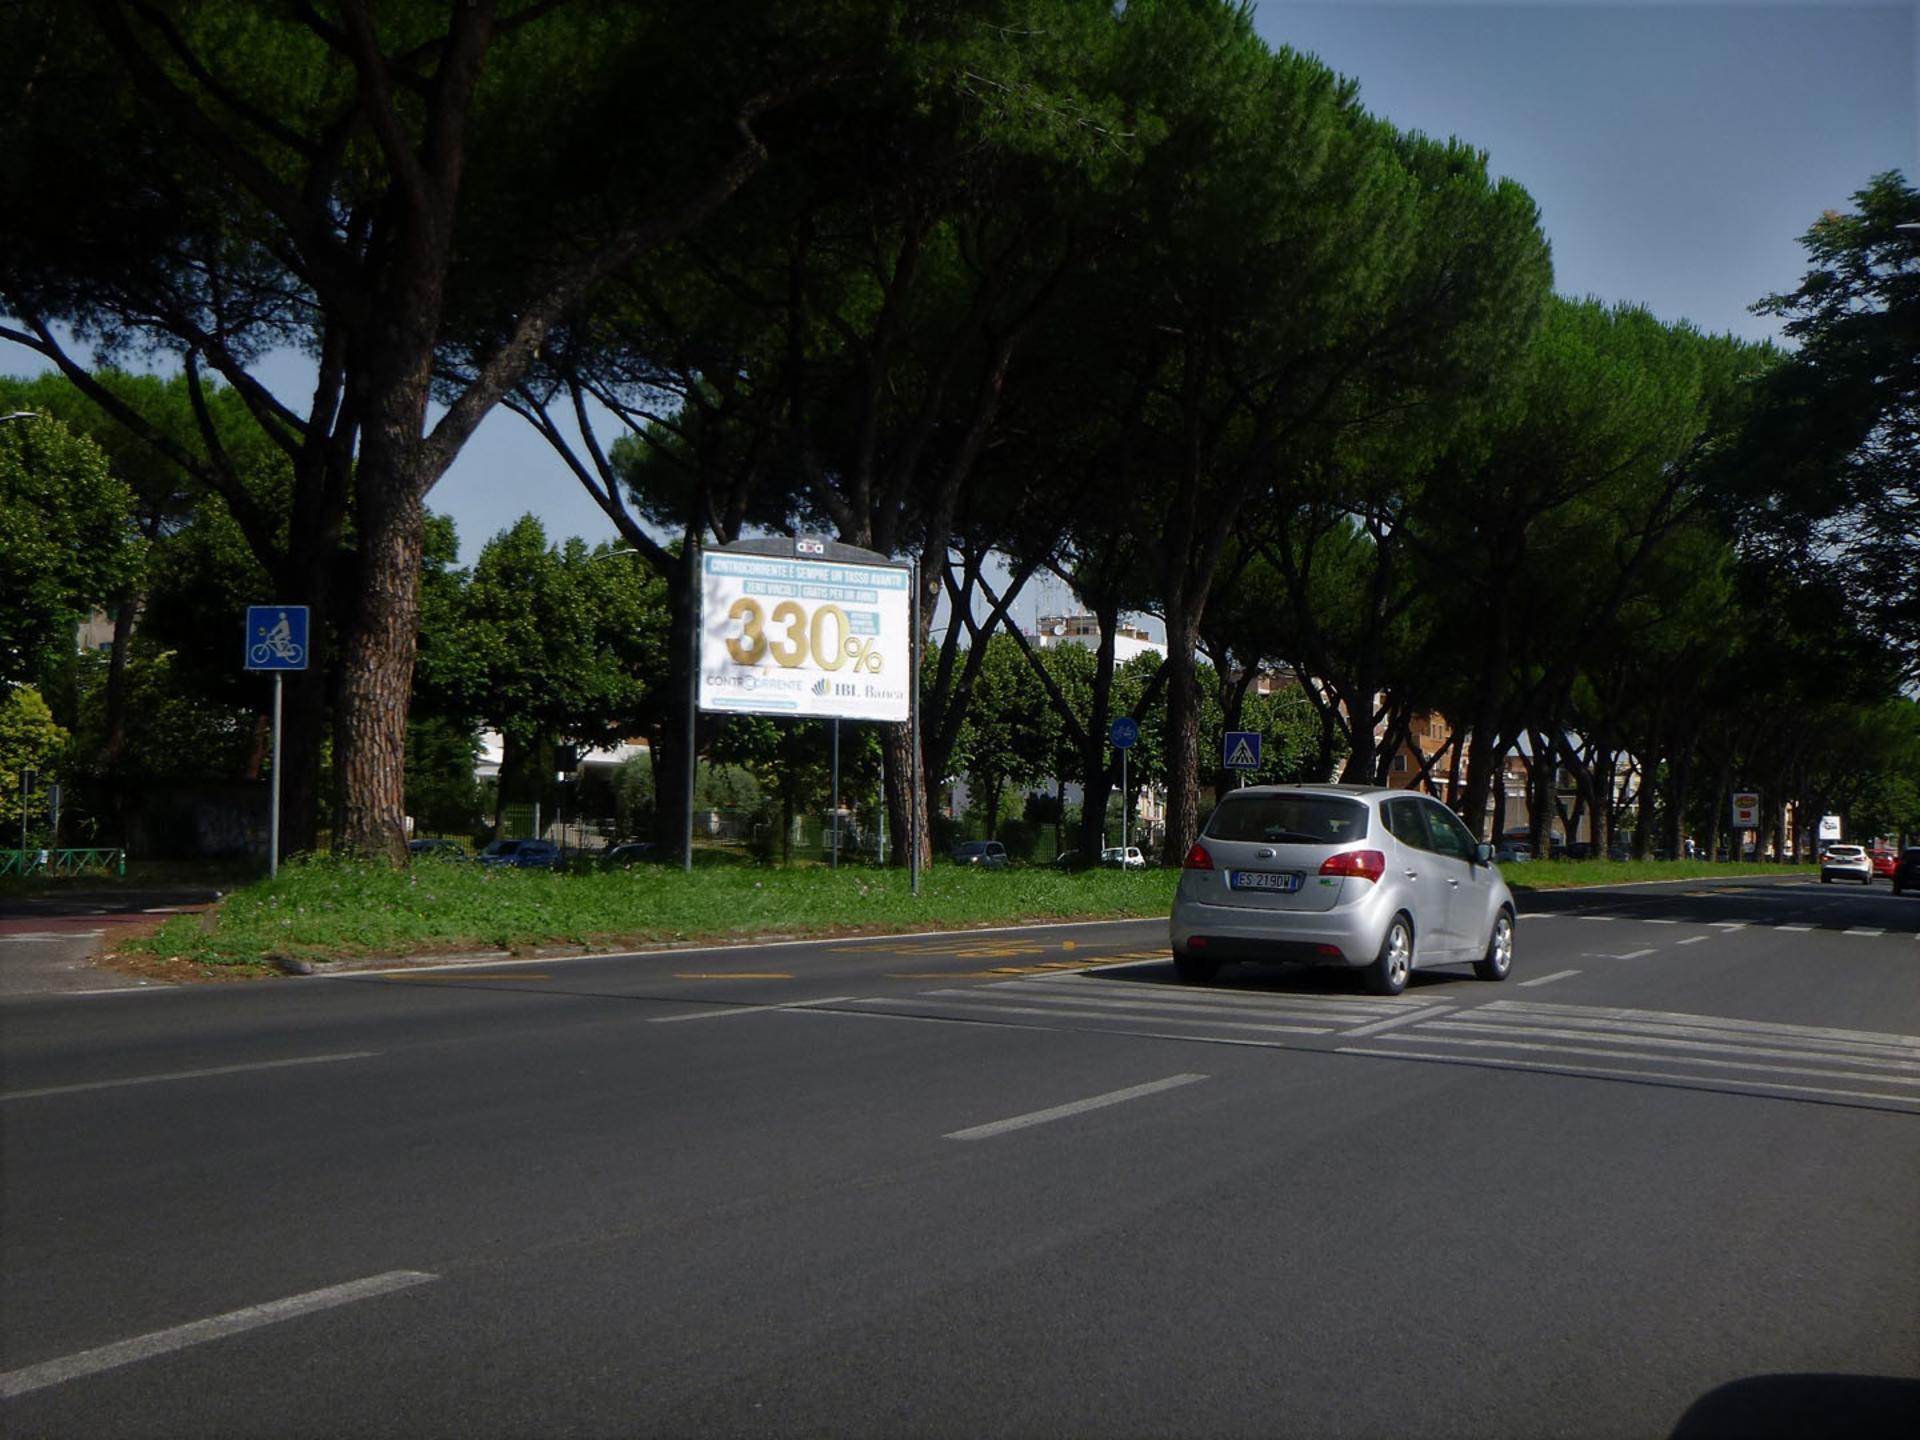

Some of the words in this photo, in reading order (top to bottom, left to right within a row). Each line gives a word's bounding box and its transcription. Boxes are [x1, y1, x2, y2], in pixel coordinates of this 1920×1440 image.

[835, 683, 859, 698] IBL
[865, 686, 904, 699] Banca
[1240, 873, 1252, 885] ES
